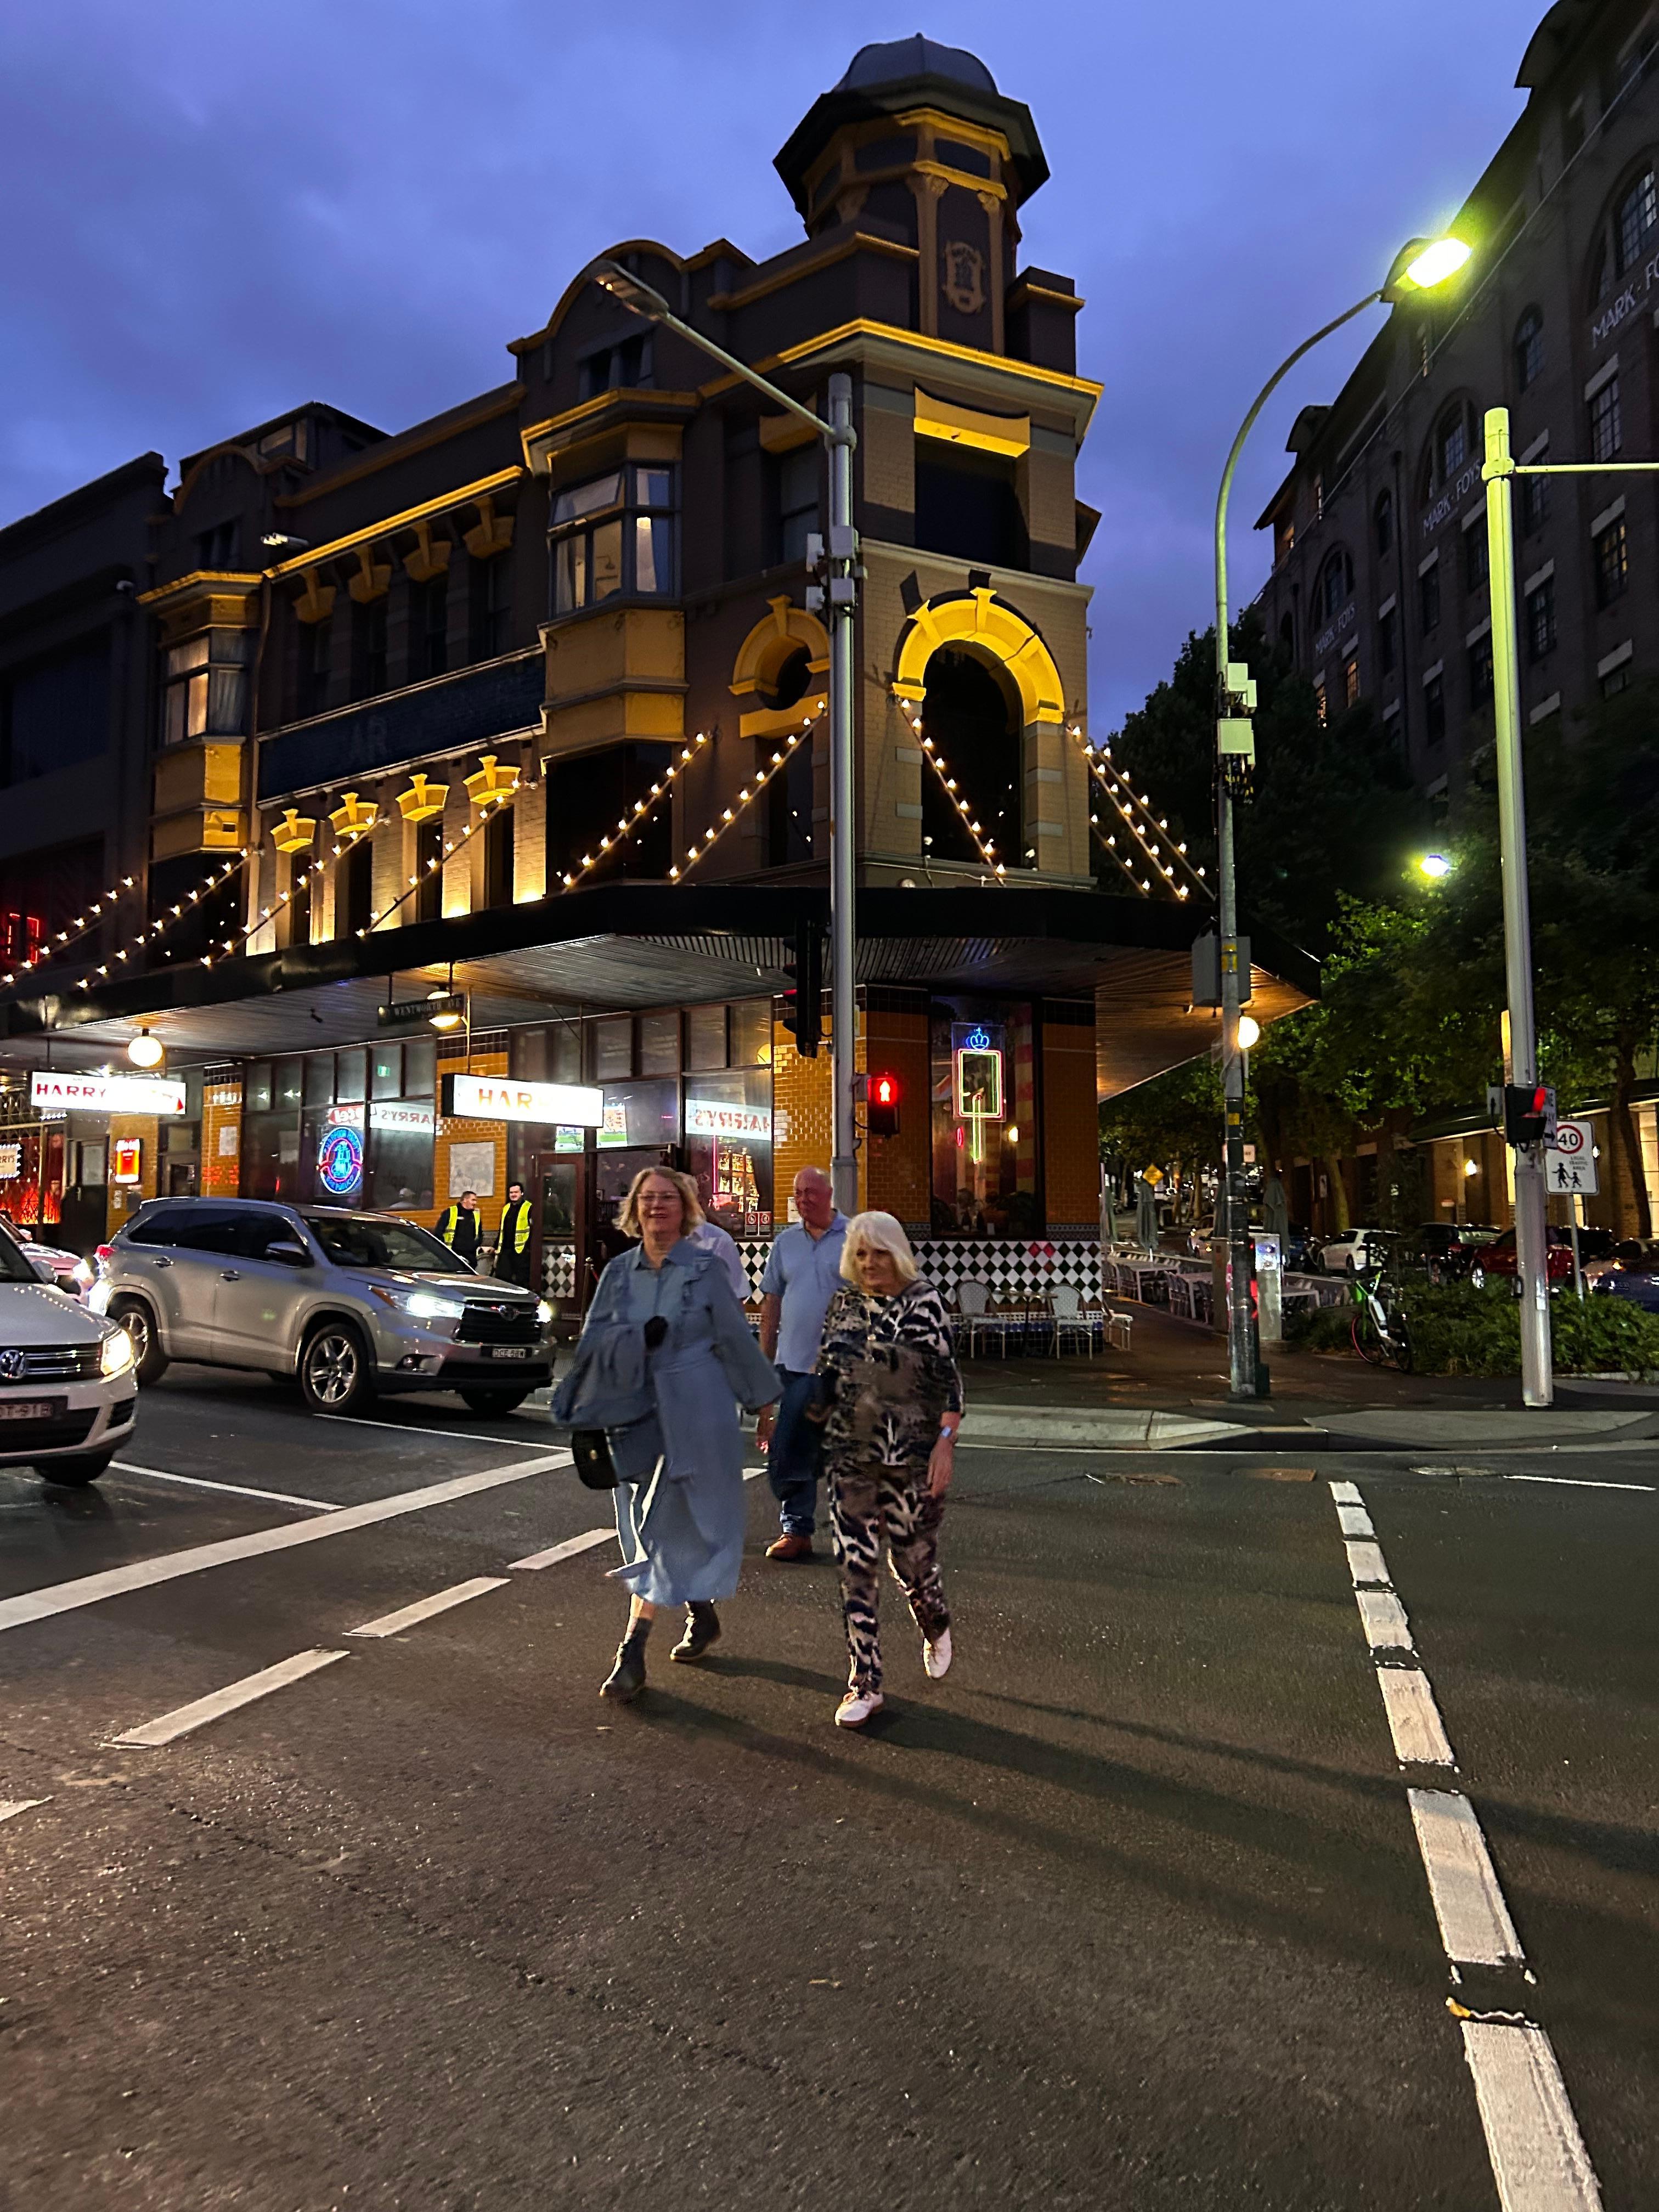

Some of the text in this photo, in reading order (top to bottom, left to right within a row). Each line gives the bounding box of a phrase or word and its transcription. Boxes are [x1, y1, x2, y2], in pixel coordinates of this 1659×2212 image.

[1593, 283, 1636, 349] MARK
[1424, 494, 1451, 537] MARK
[1558, 1133, 1578, 1146] 40
